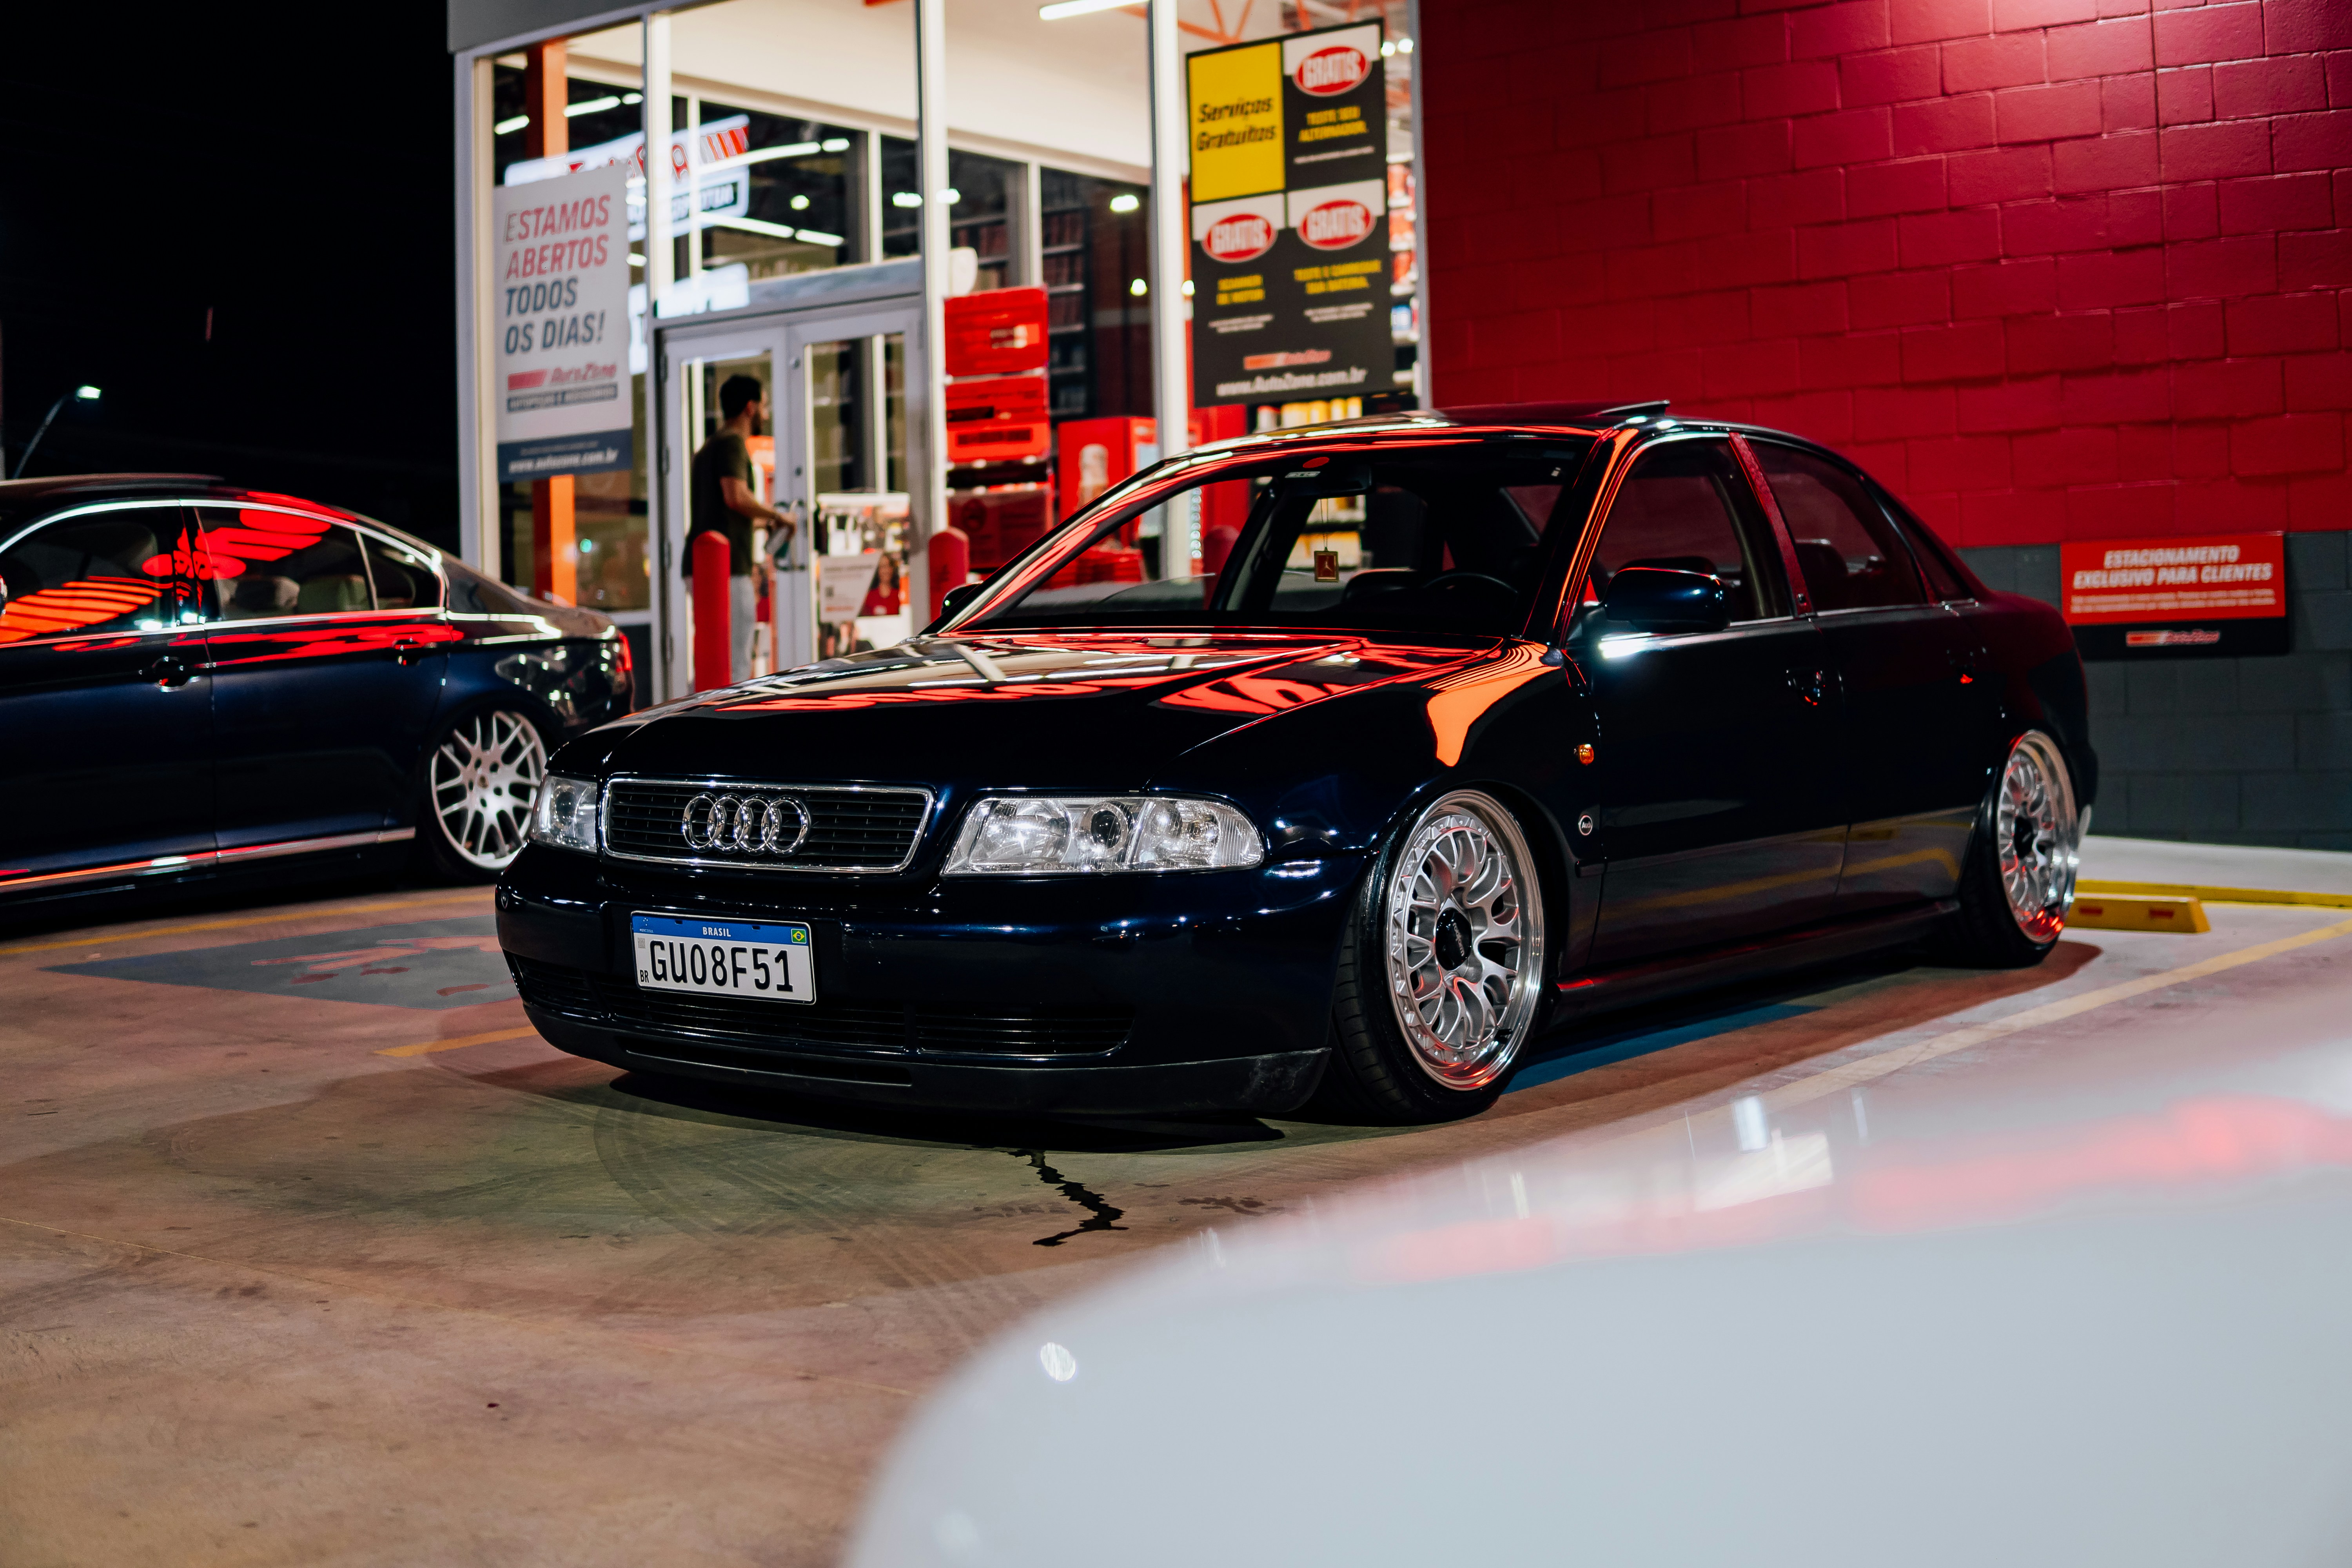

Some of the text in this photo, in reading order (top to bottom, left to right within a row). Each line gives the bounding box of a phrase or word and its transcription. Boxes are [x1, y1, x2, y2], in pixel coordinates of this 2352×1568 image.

[1199, 96, 1273, 123] Serviços
[1196, 125, 1276, 151] Gratuitos
[504, 194, 611, 243] ESTAMOS
[505, 234, 609, 280] ABERTOS
[506, 277, 578, 318] TODOS
[505, 310, 604, 355] OS DIAS!
[2103, 544, 2240, 569] ESTACIONAMENTO
[2073, 563, 2272, 590] EXCLUSIVO PARA CLIENTES
[702, 927, 731, 937] BRASIL
[640, 970, 649, 983] BR
